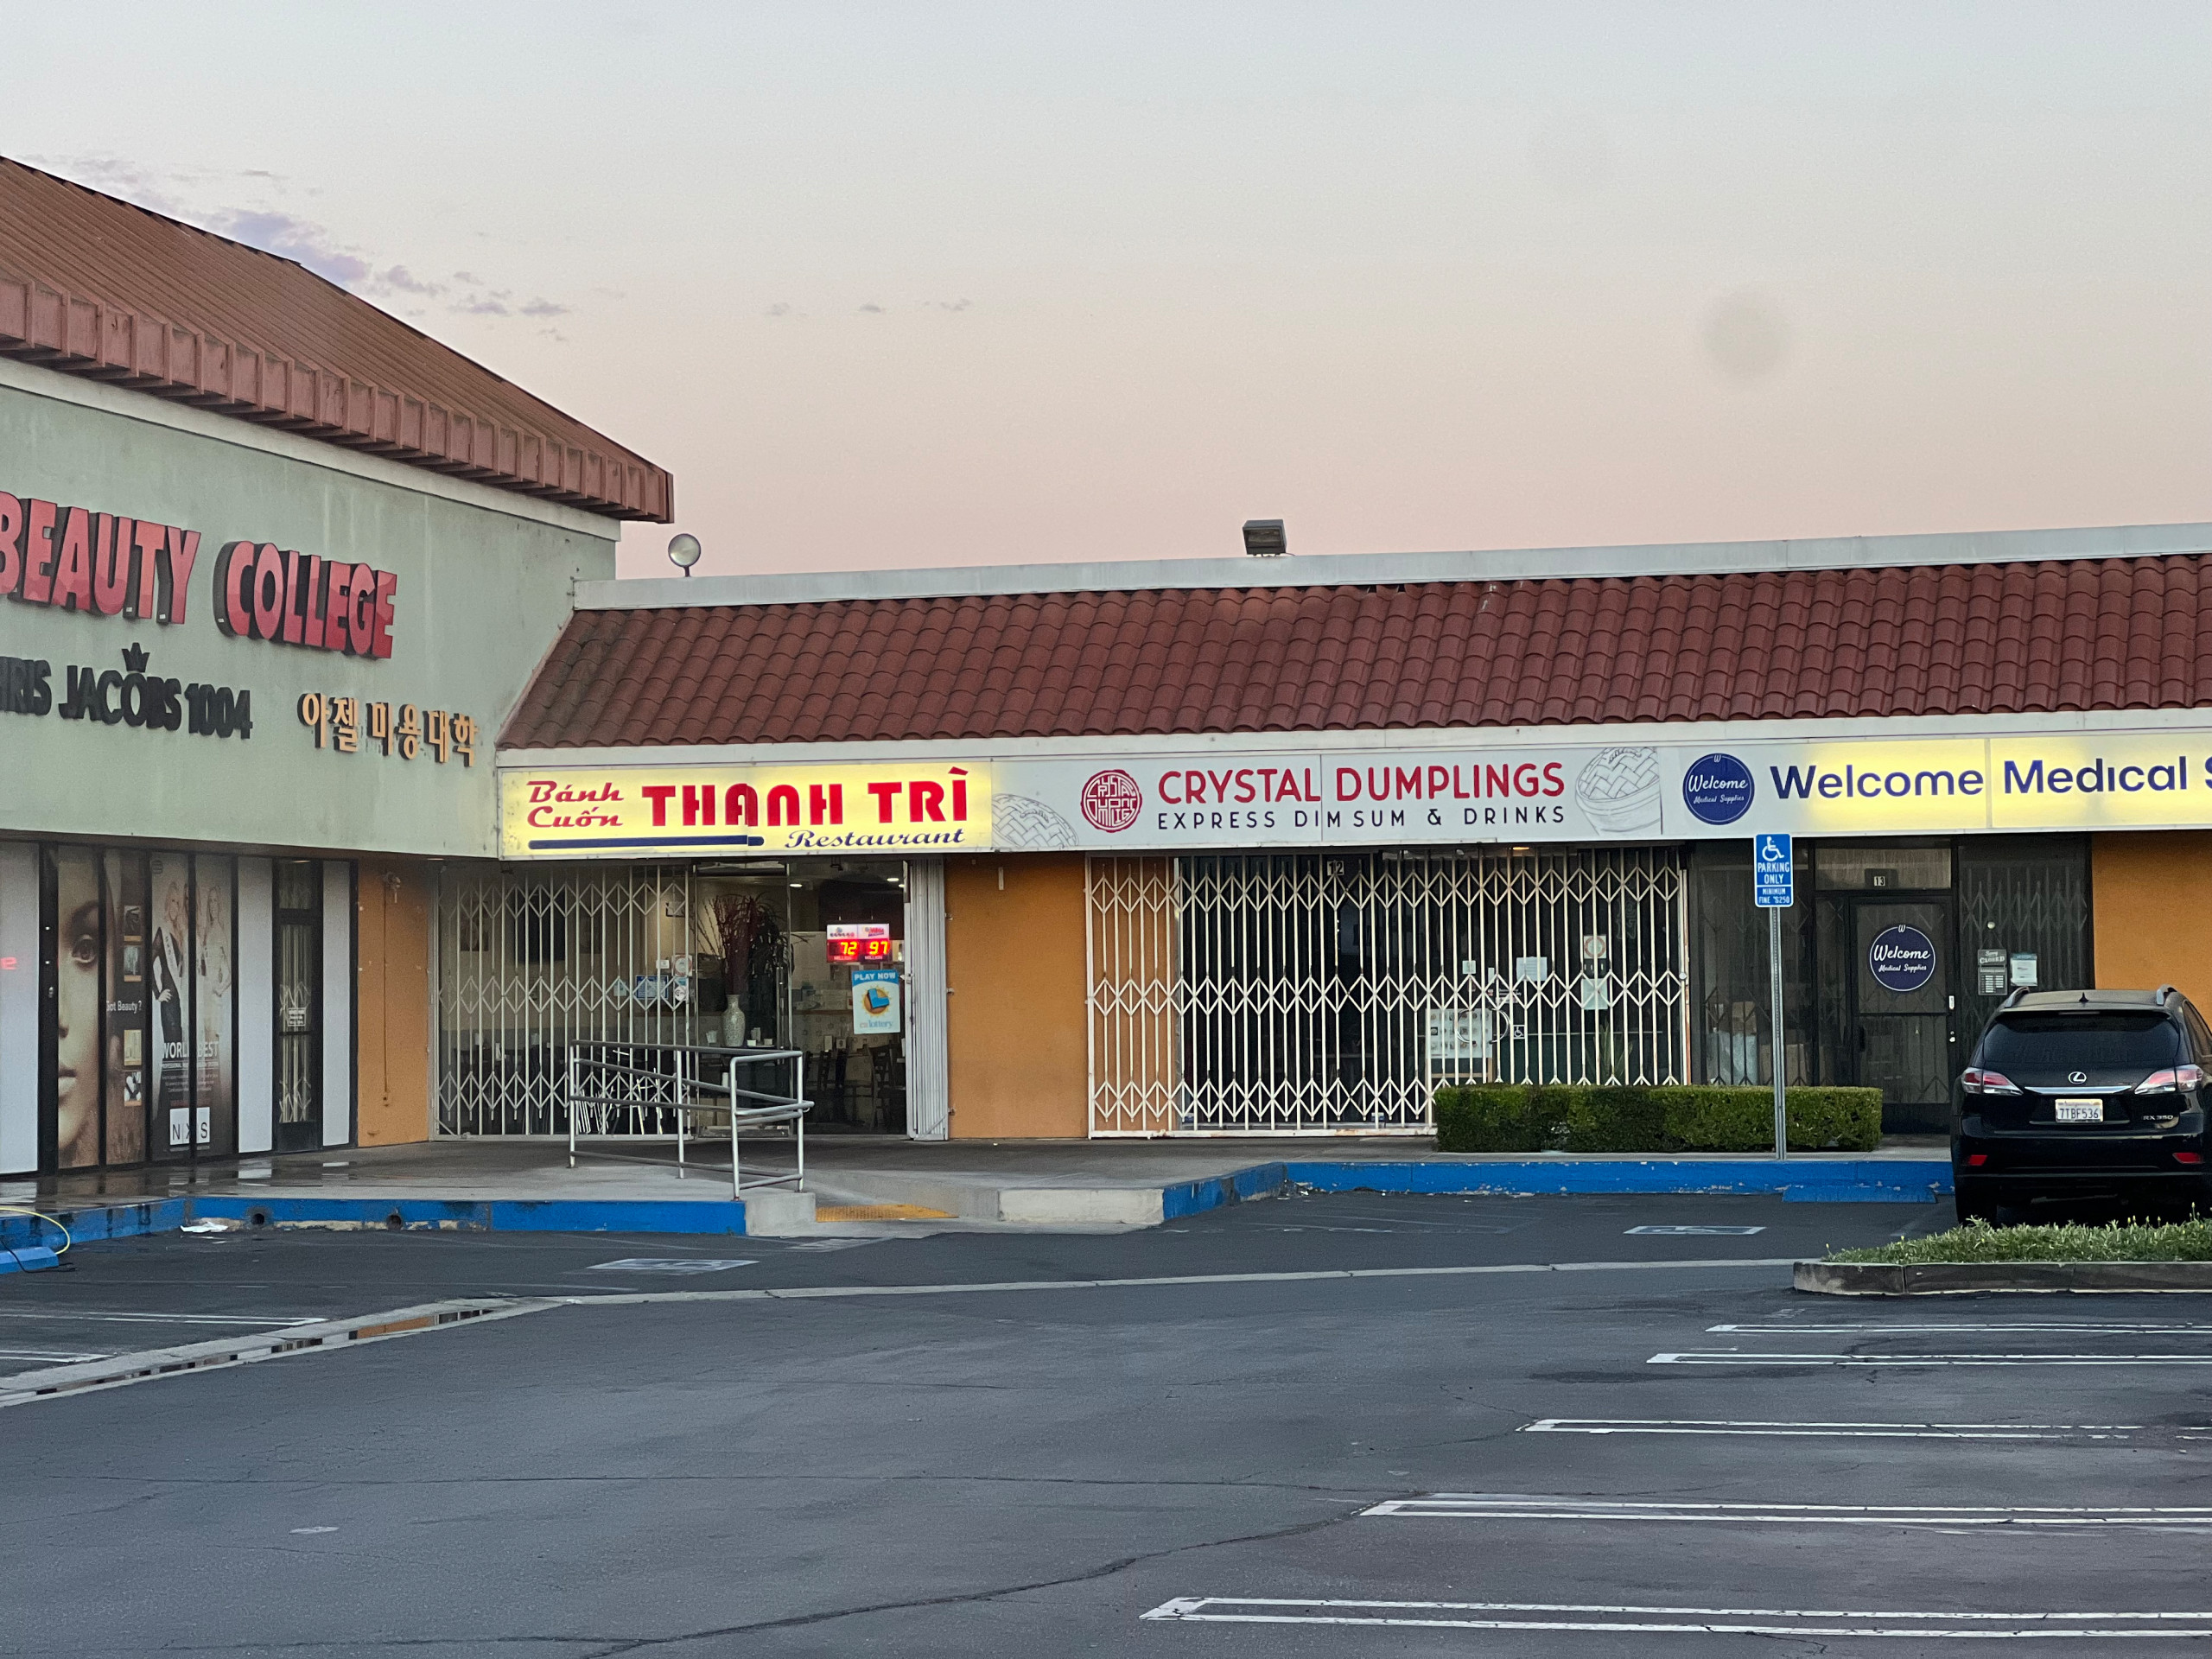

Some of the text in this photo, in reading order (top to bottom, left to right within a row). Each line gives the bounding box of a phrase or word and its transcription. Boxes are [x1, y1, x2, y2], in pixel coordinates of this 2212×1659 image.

[0, 491, 397, 659] BEAUTY COLLEGE
[59, 664, 181, 731] JACOBS
[184, 683, 253, 740] 1004
[365, 702, 479, 767] 미용대학
[1158, 762, 1566, 804] CRYSTAL DUMPLINGS
[1688, 774, 1748, 792] Welcome
[1770, 764, 1984, 798] Welcome
[526, 780, 624, 803] Bánh
[641, 766, 969, 827] THANH TRÌ
[1694, 794, 1745, 804] Medical Supplies
[1158, 805, 1566, 830] EXPRESS DIM SUM & DRINKS
[785, 828, 965, 849] Restaurant
[1758, 861, 1790, 873] PARKING
[1764, 874, 1784, 885] ONLY
[1875, 877, 1885, 886] 13
[841, 941, 858, 956] 72
[869, 940, 889, 956] 97
[1873, 944, 1931, 962] Welcome
[1878, 963, 1927, 973] Medical Supplies
[2059, 1108, 2099, 1119] 7TBF536
